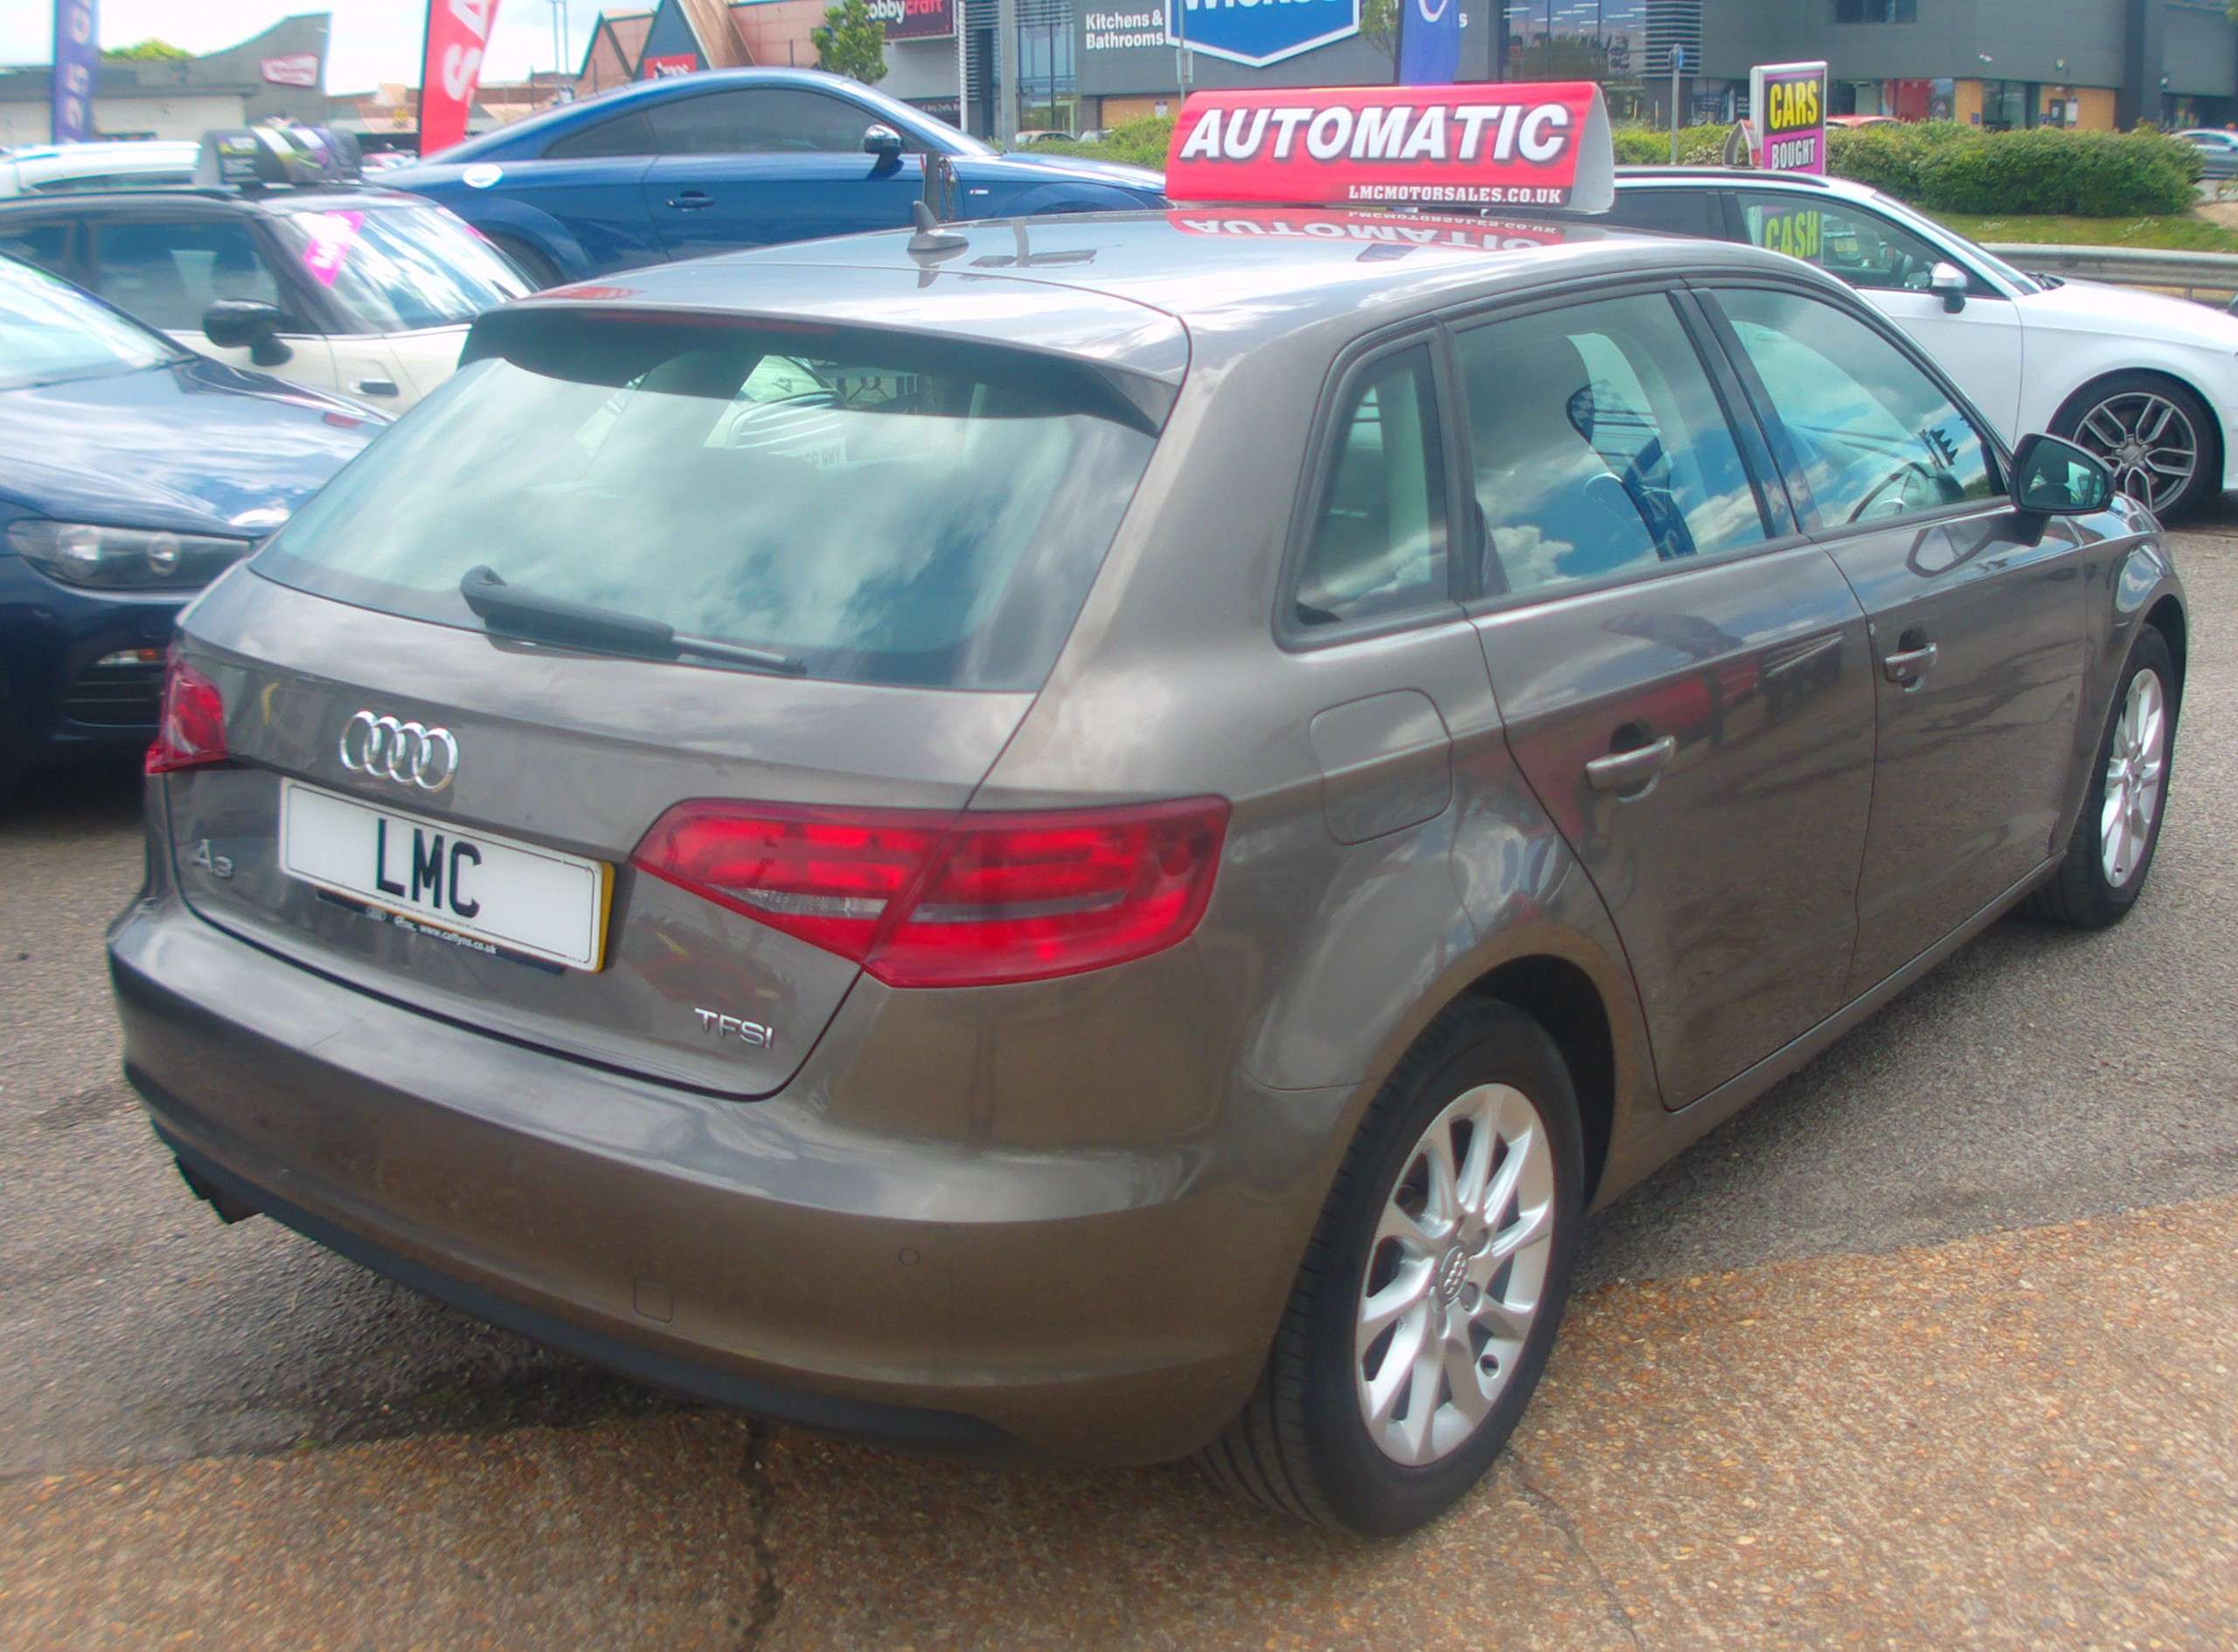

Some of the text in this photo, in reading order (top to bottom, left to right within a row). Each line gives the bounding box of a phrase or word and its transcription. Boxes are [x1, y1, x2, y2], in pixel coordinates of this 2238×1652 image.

[865, 0, 942, 24] obbycraft
[1087, 9, 1163, 30] Kitchens &
[1087, 31, 1164, 49] Bathrooms
[1769, 80, 1818, 129] CARS
[1180, 104, 1568, 162] AUTOMATIC
[1771, 138, 1816, 170] BOUGHT
[1349, 185, 1561, 204] LMCMOTORSALES.CO.UK
[1765, 211, 1818, 259] CASH
[376, 818, 482, 919] LMC
[694, 1007, 773, 1049] TFSI
